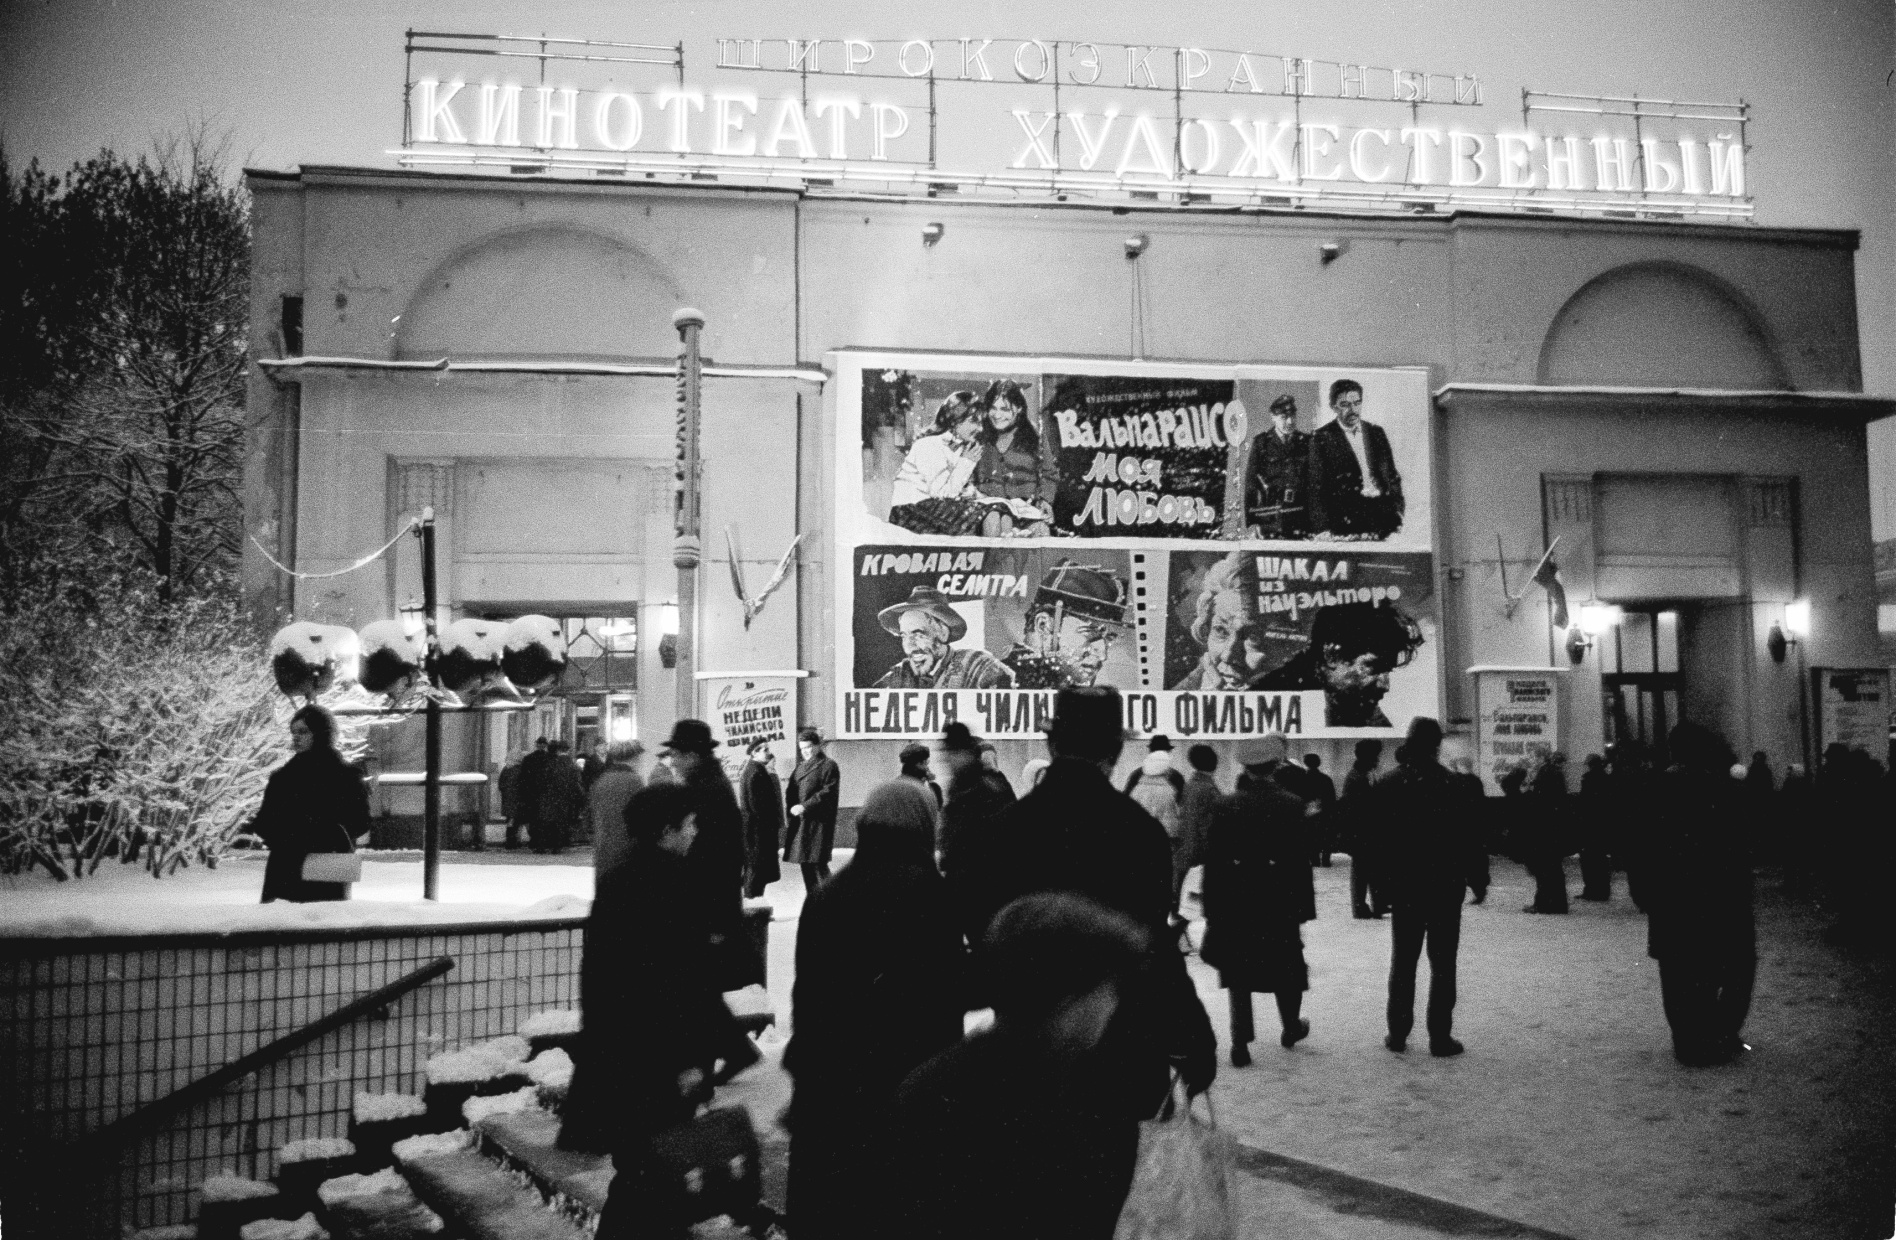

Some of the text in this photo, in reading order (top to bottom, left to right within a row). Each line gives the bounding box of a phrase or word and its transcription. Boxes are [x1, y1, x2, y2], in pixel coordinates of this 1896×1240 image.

[717, 38, 1484, 105] ШИРОКОЭКРАННЫЙ
[418, 79, 1746, 196] КИНОТЕАТР ХУДОЖЕСТВЕННЫЙ
[1073, 487, 1215, 526] ЛЮБОВЬ
[860, 552, 985, 576] КРОВАВАЯ
[1256, 556, 1348, 582] ШАКАЛ
[937, 574, 1029, 598] СЕЛИТРА
[723, 705, 782, 724] НЕДЕЛИ
[844, 692, 1302, 736] НЕДЕЛЯ ЧИЛИГО ФИЛЬМА
